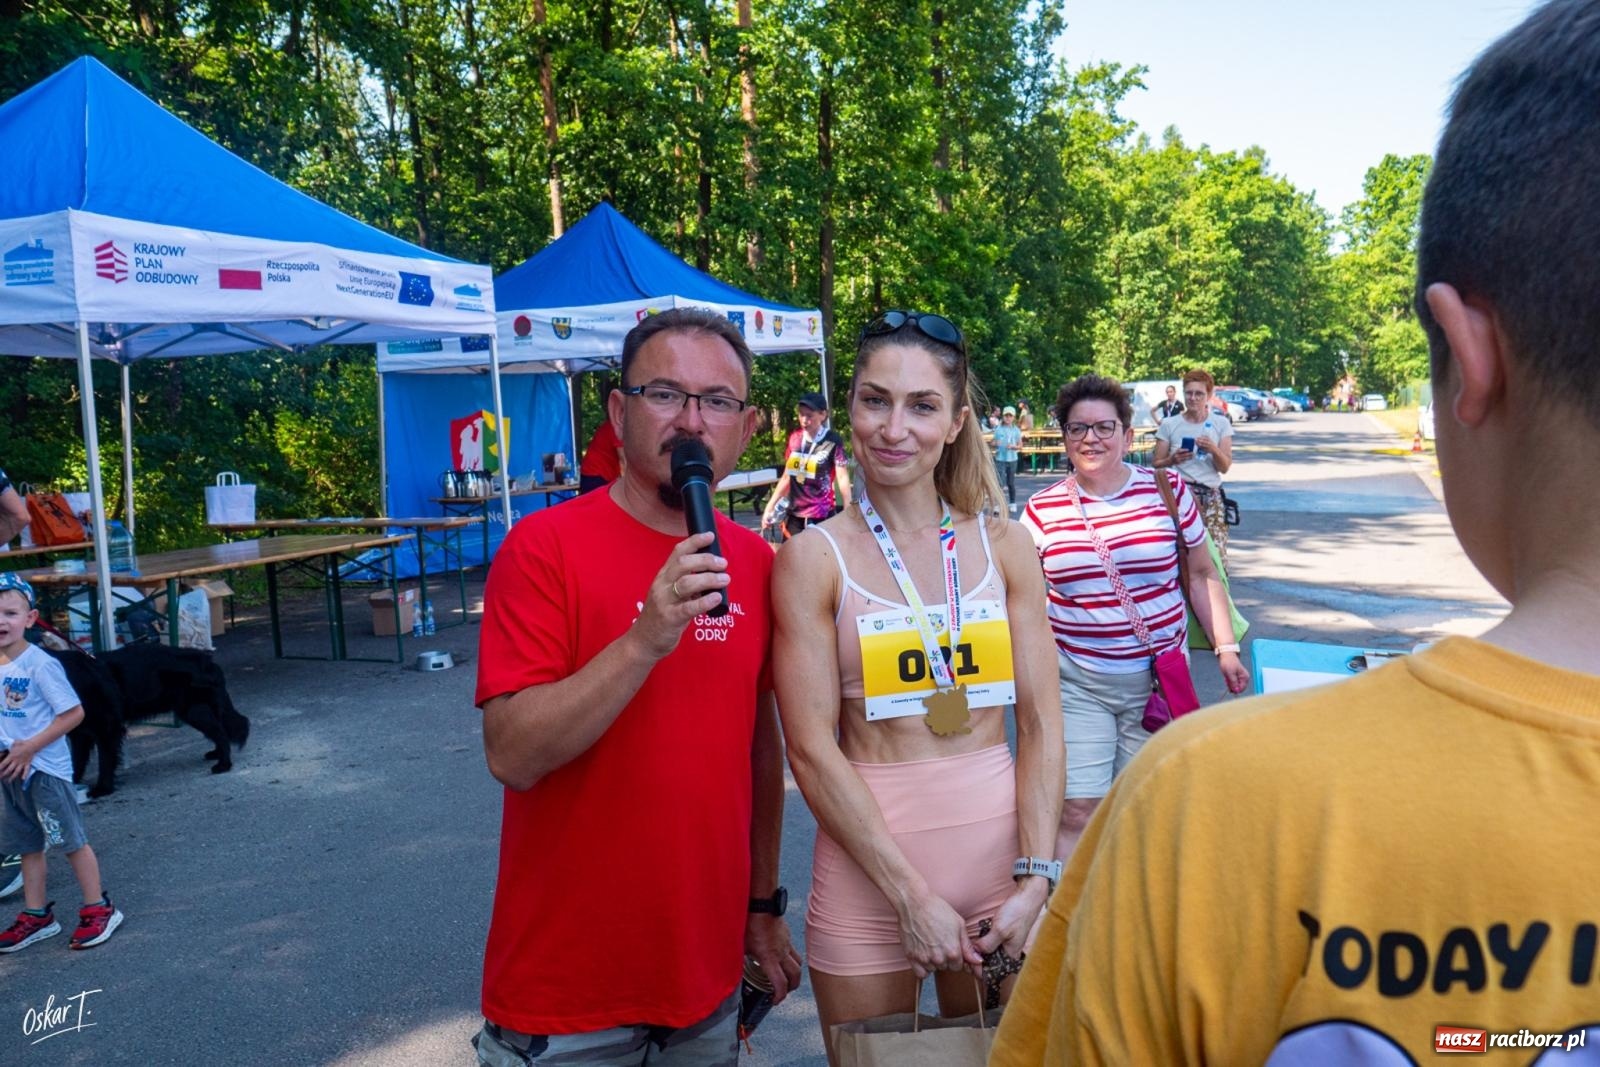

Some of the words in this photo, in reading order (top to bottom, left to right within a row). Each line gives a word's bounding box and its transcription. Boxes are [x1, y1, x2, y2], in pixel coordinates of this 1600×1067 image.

[133, 242, 186, 257] KRAJOWY
[135, 258, 163, 270] PLAN
[266, 259, 320, 272] Rzeczpospolita
[135, 271, 199, 286] ODBUDOWY
[267, 272, 291, 282] Polska
[487, 509, 521, 525] Nęza
[695, 628, 728, 642] ODRY
